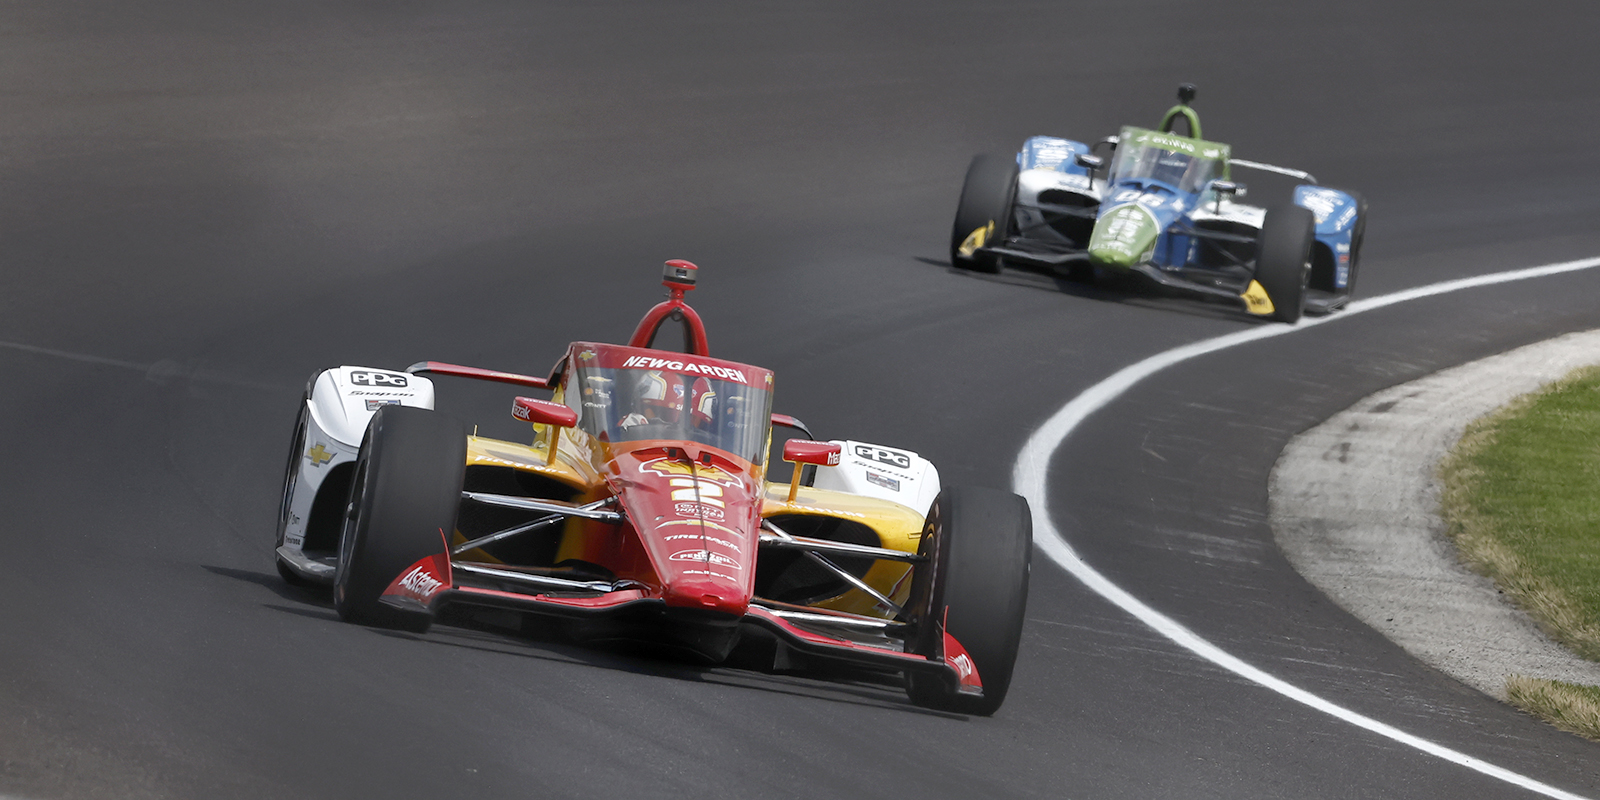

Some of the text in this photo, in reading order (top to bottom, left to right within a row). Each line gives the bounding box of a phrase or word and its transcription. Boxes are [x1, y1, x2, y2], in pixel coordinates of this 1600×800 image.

[351, 373, 406, 386] PPG
[622, 356, 748, 384] NEWGARDEN
[856, 447, 910, 467] PPG
[669, 479, 725, 509] 2
